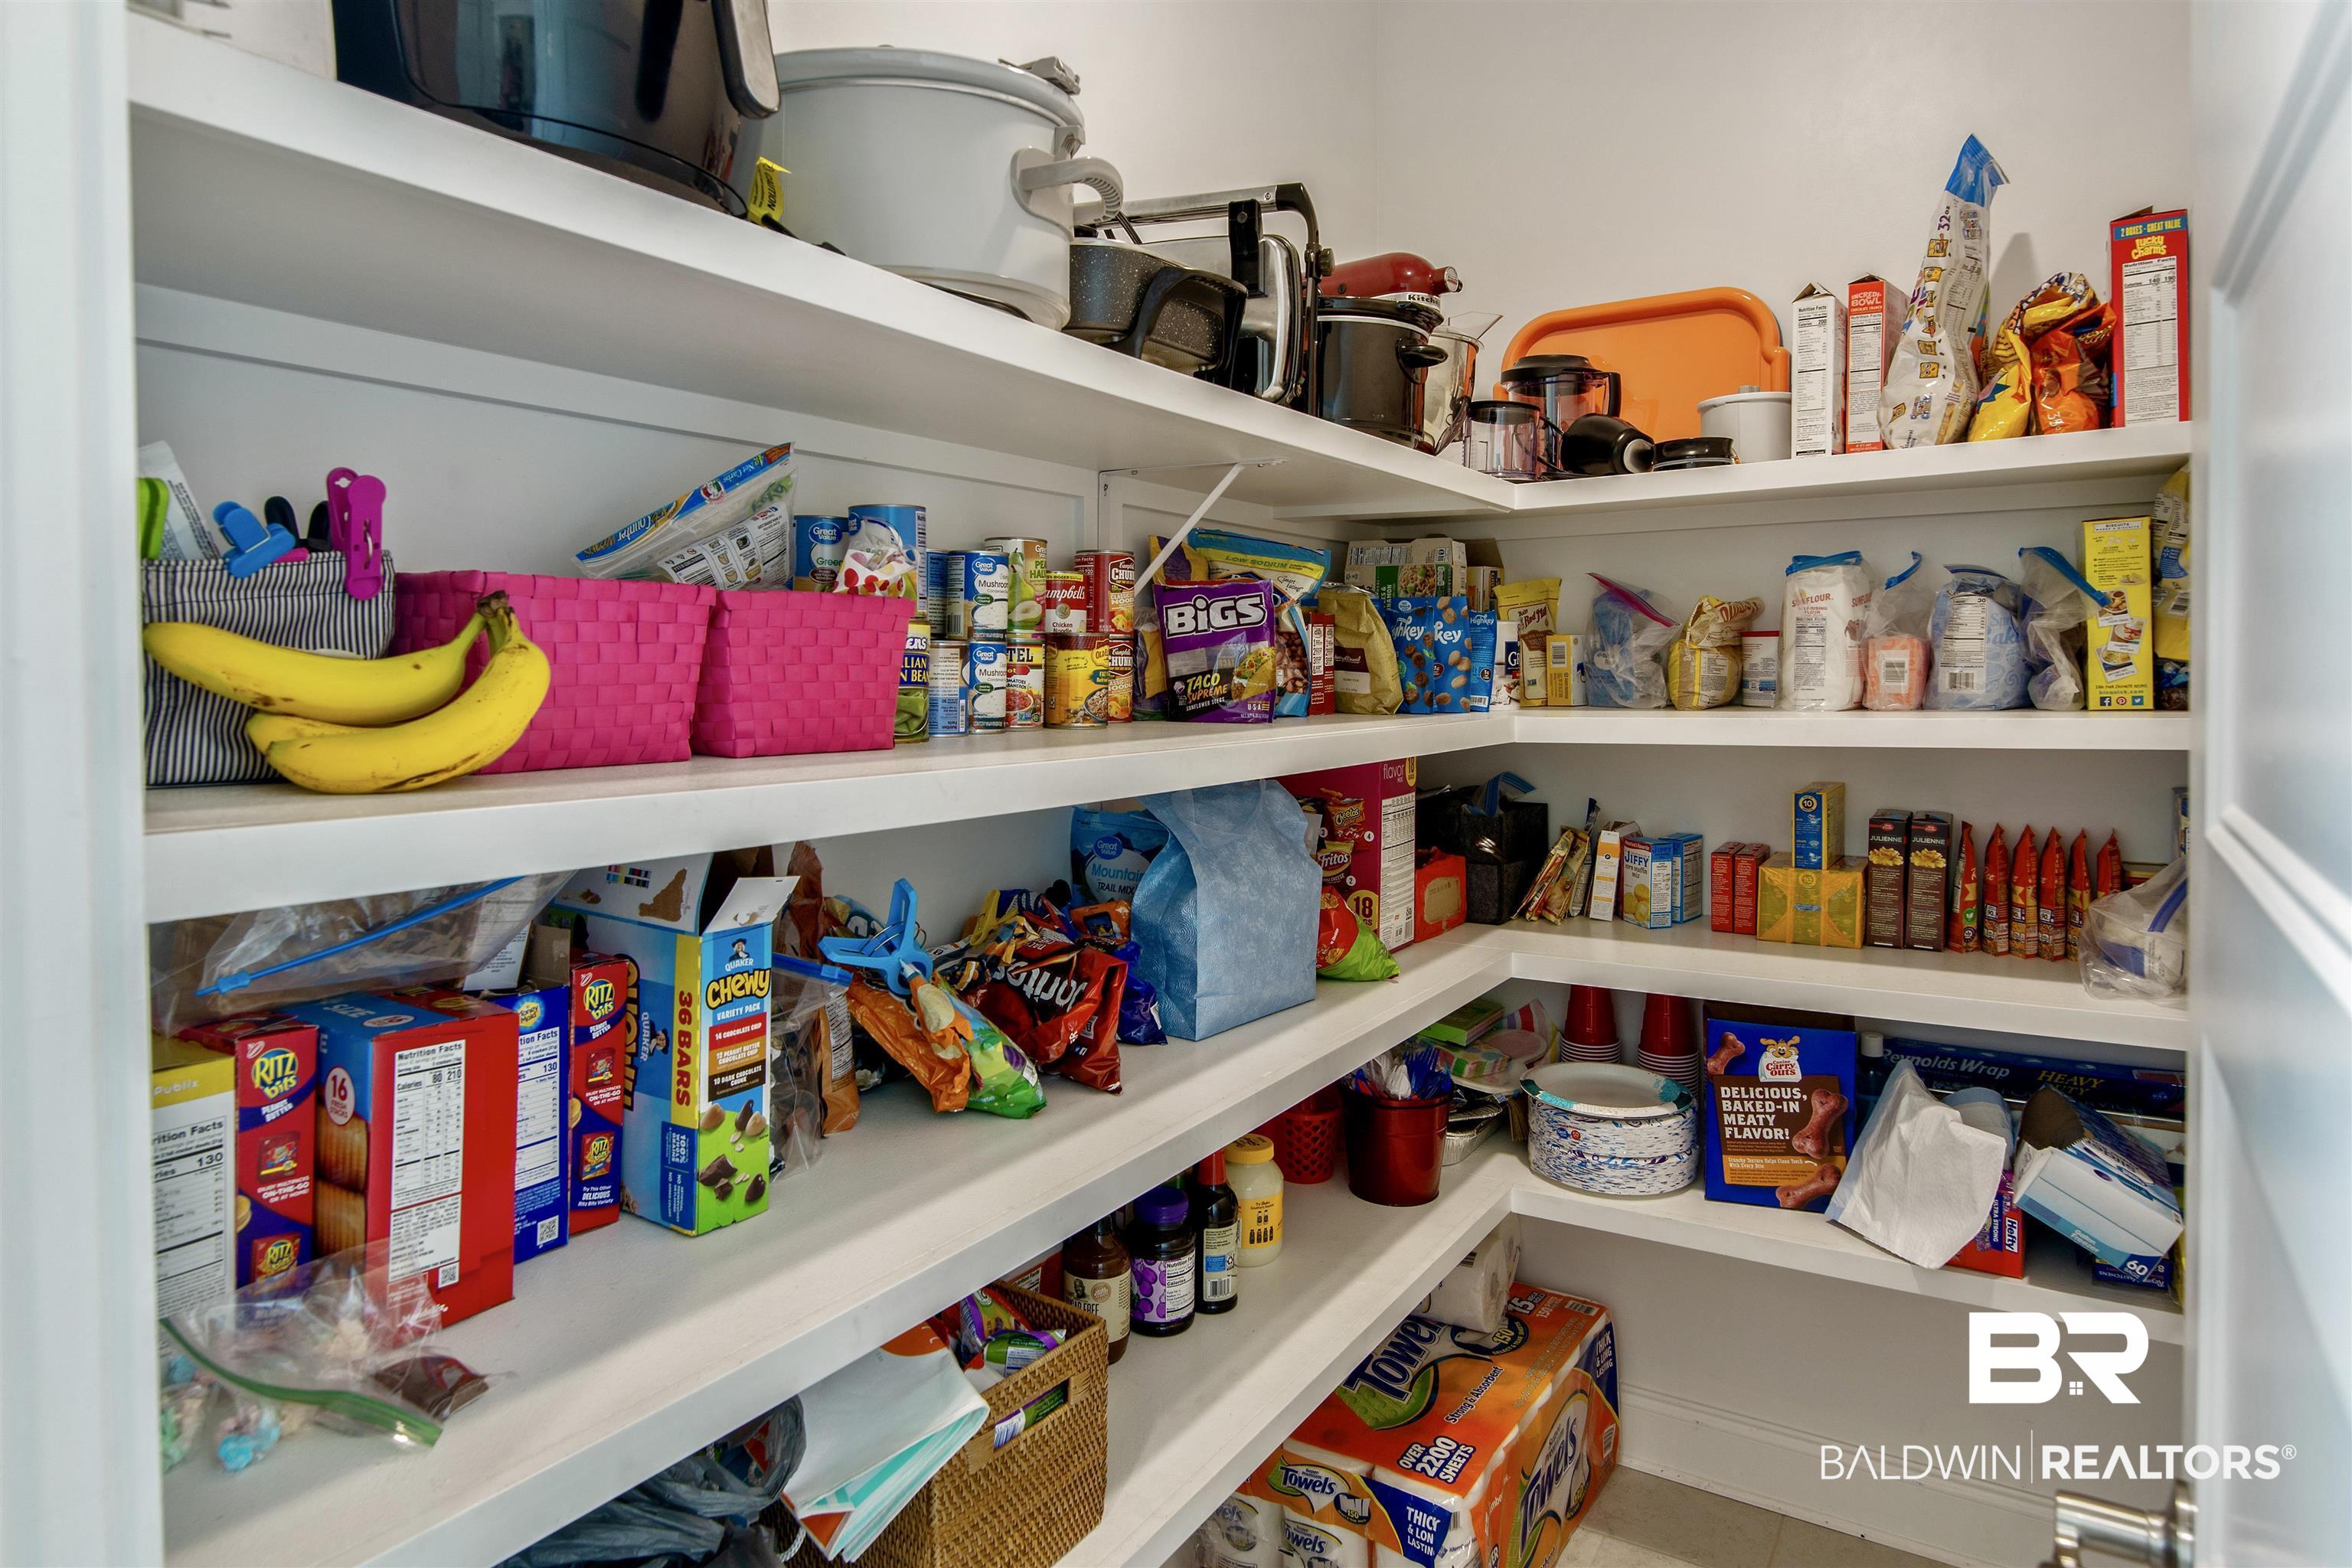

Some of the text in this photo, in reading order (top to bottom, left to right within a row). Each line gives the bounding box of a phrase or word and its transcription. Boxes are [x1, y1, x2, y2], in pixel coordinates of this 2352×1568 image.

[766, 173, 776, 211] CAUTION
[2121, 228, 2125, 237] 2
[2147, 221, 2163, 232] GREAT
[2165, 219, 2180, 229] VALUE
[2132, 245, 2167, 260] Charms
[1851, 297, 1881, 306] BOWL
[618, 514, 651, 542] Counter
[812, 527, 837, 537] Great
[1250, 559, 1288, 569] SODIUM
[1282, 576, 1295, 584] Smart
[1187, 673, 1220, 694] TACO
[1188, 684, 1228, 704] SUPREME
[1186, 701, 1210, 711] SUNFLOWER
[1383, 764, 1404, 779] flavor
[1335, 808, 1360, 825] Cheetos
[1097, 841, 1117, 851] Great
[1912, 837, 1945, 845] JULIENNE
[1318, 853, 1348, 867] Fritos
[1625, 850, 1649, 867] JIFFY
[1634, 865, 1648, 874] muffin
[1098, 882, 1135, 894] TRAIL MIX
[1354, 896, 1374, 918] 18
[725, 958, 754, 972] QUAKER
[584, 982, 612, 1011] RITZ
[591, 1001, 614, 1020] bits
[717, 1002, 761, 1021] VARIETY PACK
[537, 1029, 557, 1040] Facts
[640, 1012, 650, 1062] QUAKER
[715, 1022, 762, 1040] 14 CHOCOLATE CHIP
[397, 1042, 462, 1061] Nutrition Facts
[676, 991, 692, 1107] 36 BARS
[253, 1053, 296, 1088] RITZ
[543, 1062, 557, 1073] 130
[736, 1065, 762, 1080] CHOCOLATE
[1766, 1063, 1795, 1071] Carry
[1959, 1059, 2010, 1080] Wrap
[263, 1074, 297, 1099] bits
[332, 1075, 348, 1101] 16
[397, 1069, 462, 1091] Calories 80 210
[2037, 1070, 2105, 1089] HEAVY
[589, 1089, 621, 1102] ON-THE-GO
[1720, 1086, 1808, 1101] DELICIOUS,
[1722, 1100, 1800, 1112] BAKED-IN
[191, 1120, 224, 1136] Facts
[1723, 1114, 1775, 1125] MEATY
[1725, 1127, 1790, 1139] FLAVOR!
[592, 1140, 609, 1155] RITZ
[197, 1153, 224, 1167] 130
[262, 1181, 309, 1199] ON-THE-GO
[583, 1191, 610, 1200] DELICIOUS
[2006, 1218, 2017, 1253] Hefty
[2070, 1233, 2099, 1253] Freezer
[2074, 1229, 2096, 1244] Gallon
[1167, 1260, 1187, 1269] Nutrition
[2126, 1259, 2149, 1276] 60
[1167, 1278, 1186, 1286] Calories
[1508, 1296, 1536, 1315] 75
[1492, 1327, 1515, 1347] 150
[1595, 1329, 1612, 1354] THICK
[1445, 1366, 1505, 1424] Strong Absorbent
[1398, 1443, 1426, 1470] OVER
[1416, 1436, 1458, 1478] 2200
[1439, 1444, 1474, 1483] SHEETS
[1280, 1466, 1337, 1495] Towels
[1347, 1510, 1360, 1518] 150
[1406, 1506, 1441, 1532] THICK
[1284, 1524, 1327, 1553] owels
[1416, 1527, 1434, 1545] LON
